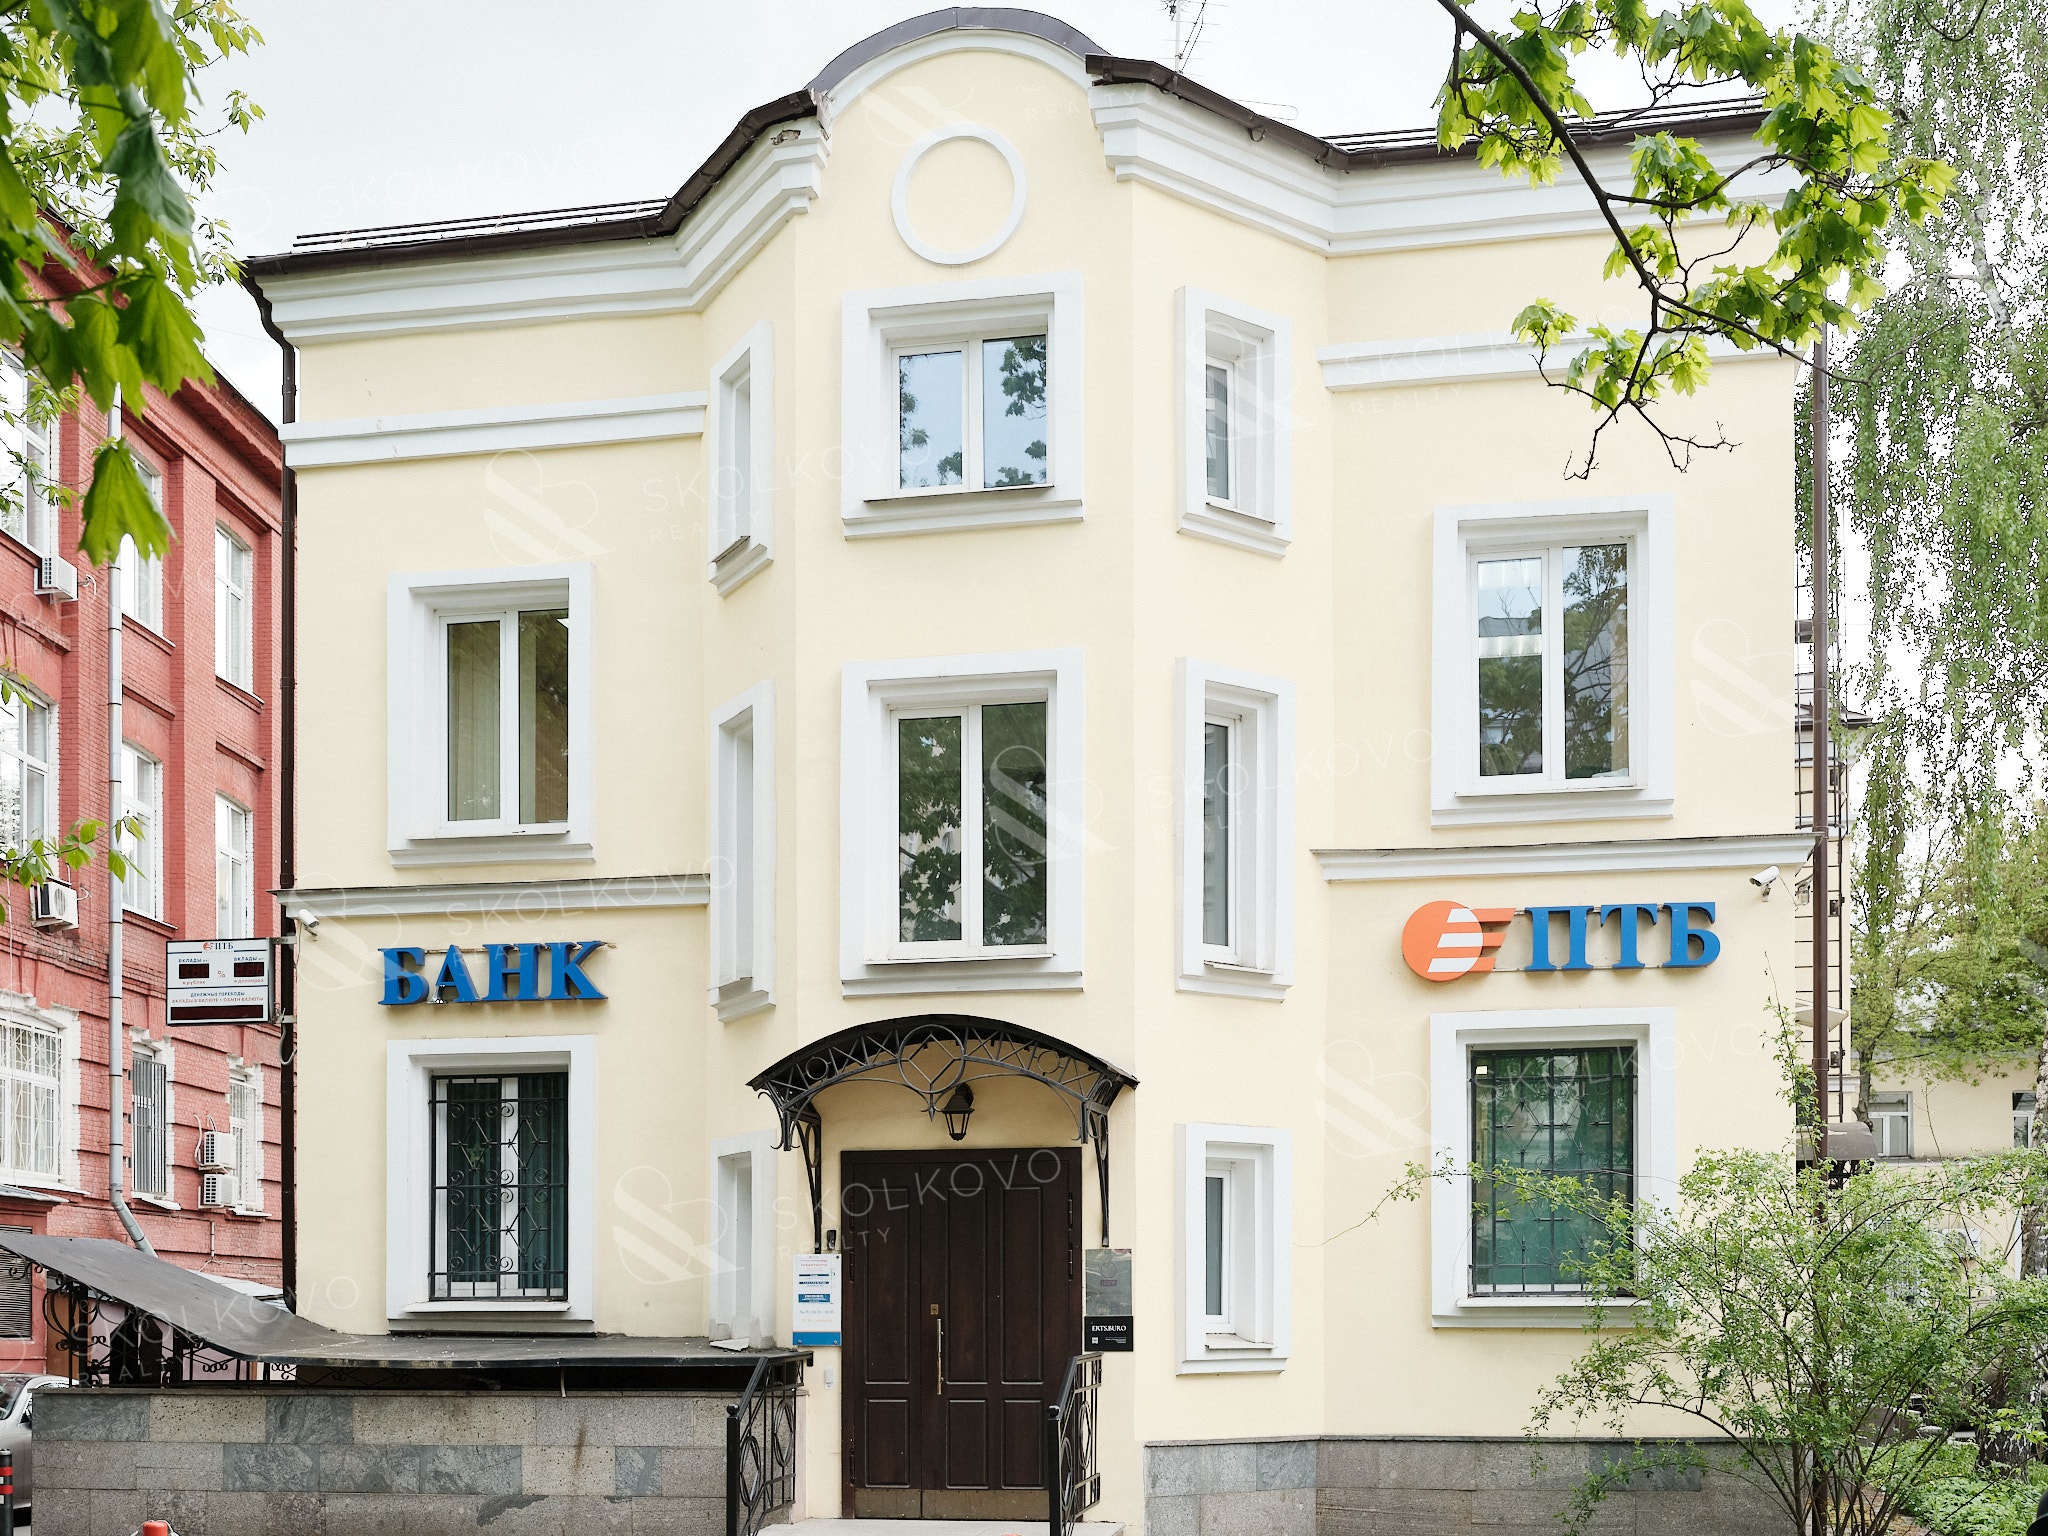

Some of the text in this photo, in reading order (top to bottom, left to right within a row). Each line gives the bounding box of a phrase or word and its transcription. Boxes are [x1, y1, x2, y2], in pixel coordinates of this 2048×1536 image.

[215, 942, 234, 950] ПТБ
[1525, 902, 1721, 972] ПТБ
[378, 940, 609, 1006] БАНК
